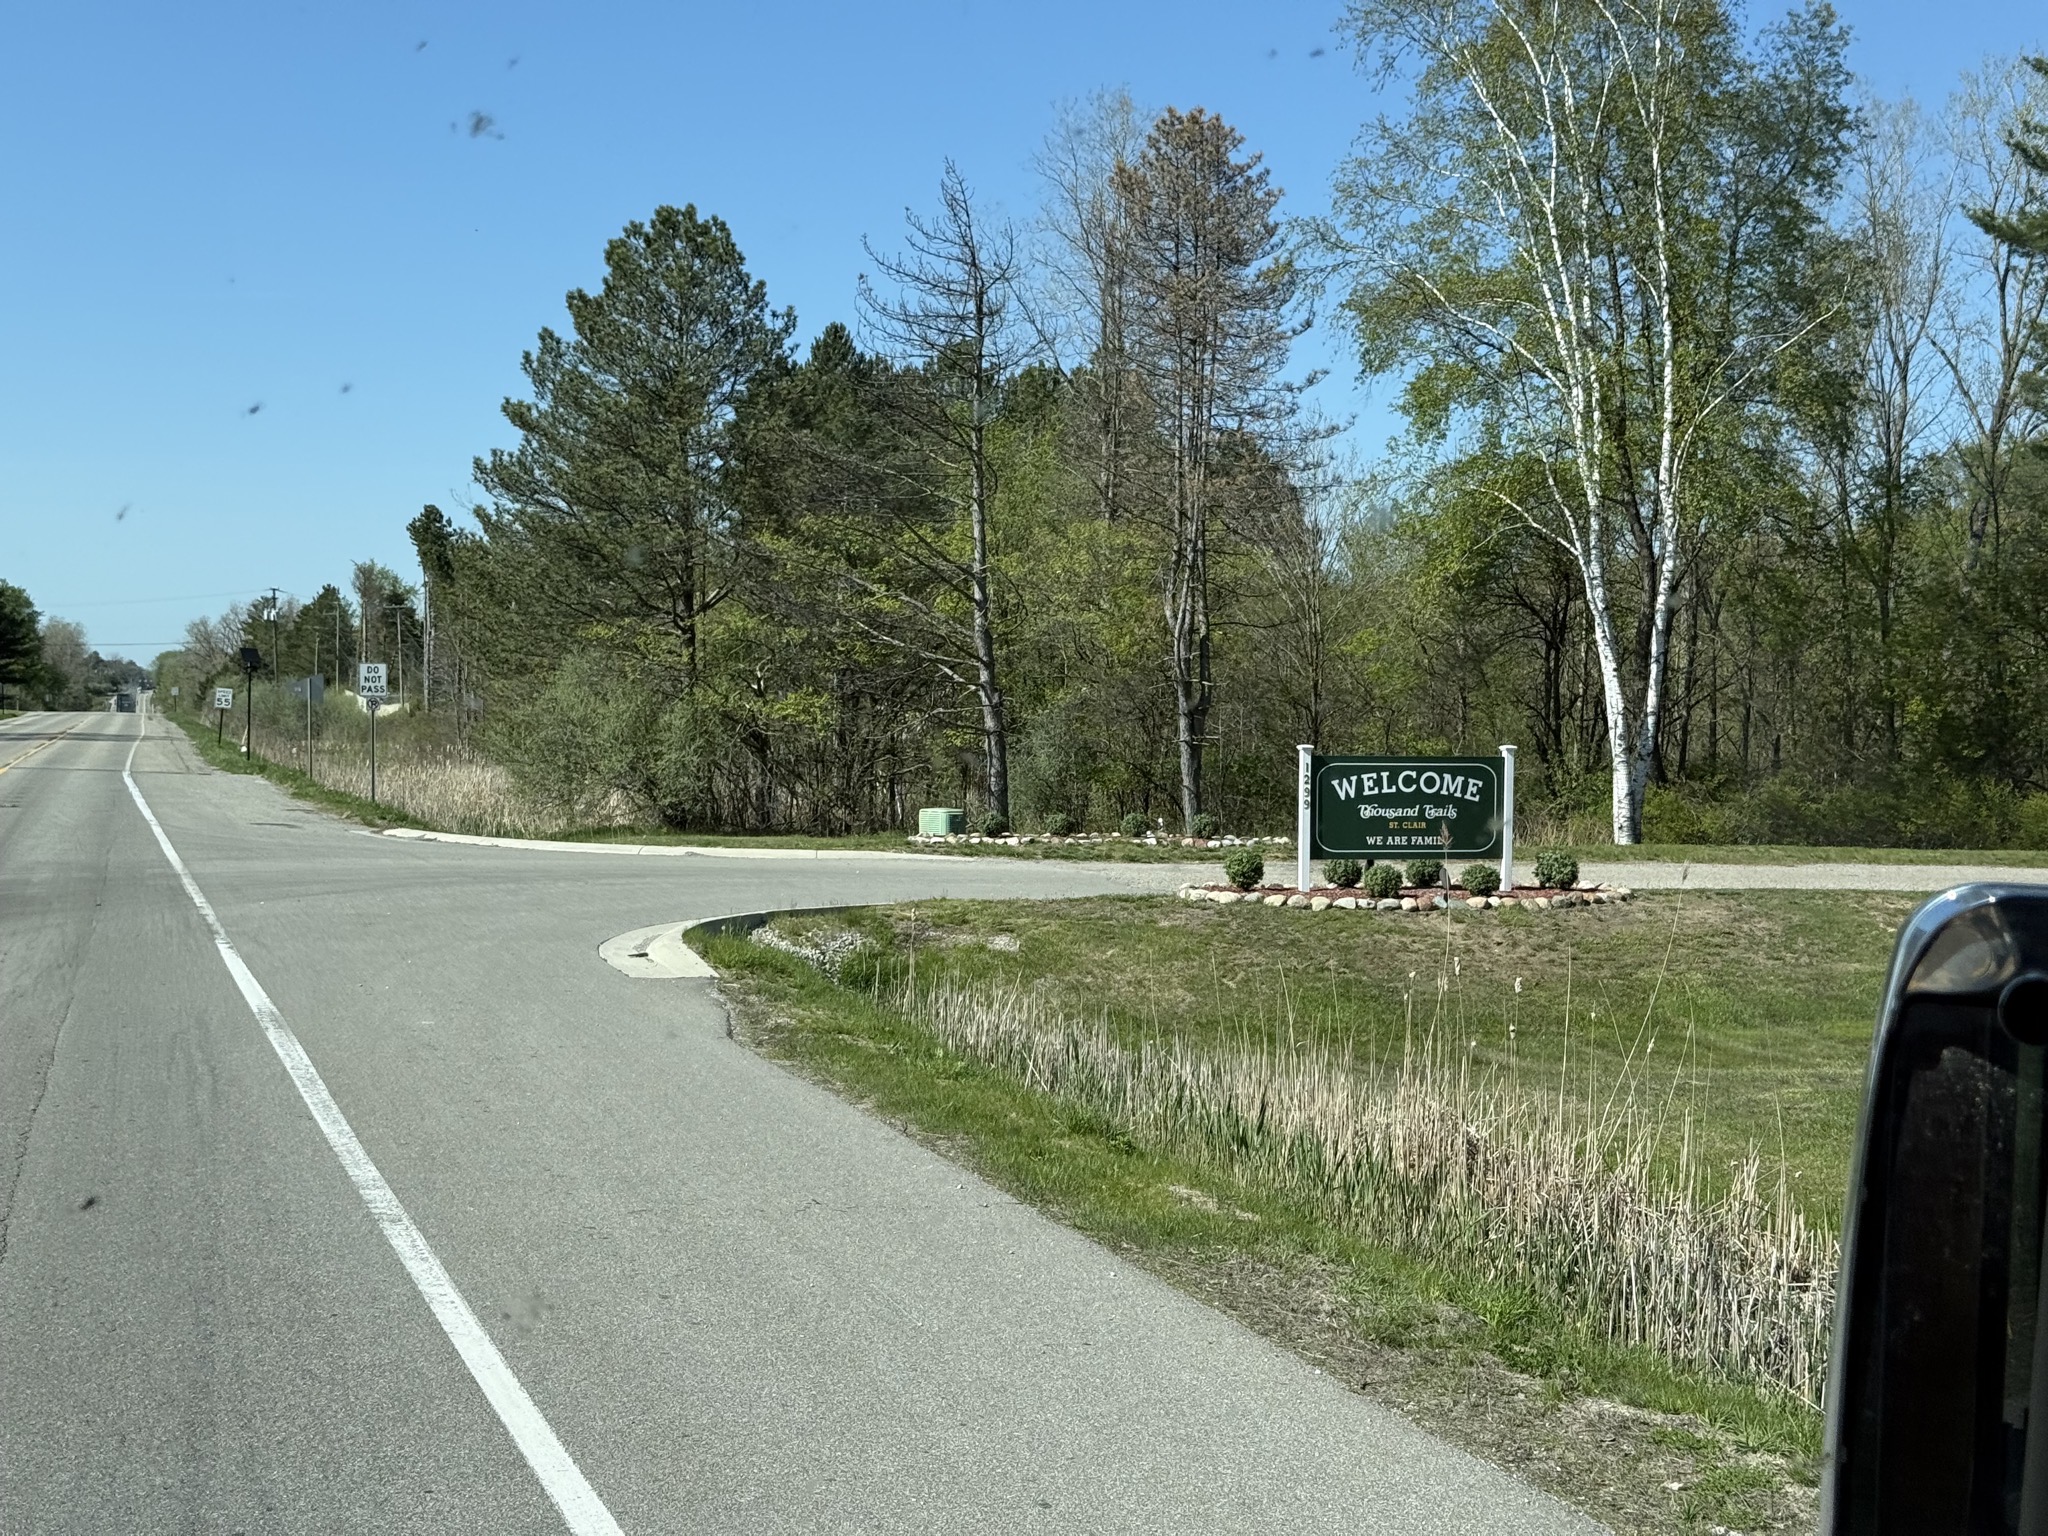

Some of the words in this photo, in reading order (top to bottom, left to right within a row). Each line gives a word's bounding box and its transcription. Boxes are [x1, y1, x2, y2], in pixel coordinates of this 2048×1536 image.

[366, 665, 380, 674] DO
[364, 675, 382, 684] NOT
[361, 685, 386, 694] PASS
[216, 698, 231, 707] 55
[1303, 762, 1311, 810] 1299
[1331, 770, 1483, 802] WELCOME
[1357, 804, 1419, 819] Thousand
[1423, 804, 1458, 819] Trails
[1388, 821, 1400, 829] ST.
[1402, 821, 1427, 829] CLAIR
[1366, 836, 1384, 846] WE
[1386, 836, 1408, 846] ARE
[1410, 836, 1450, 846] FAMIL
